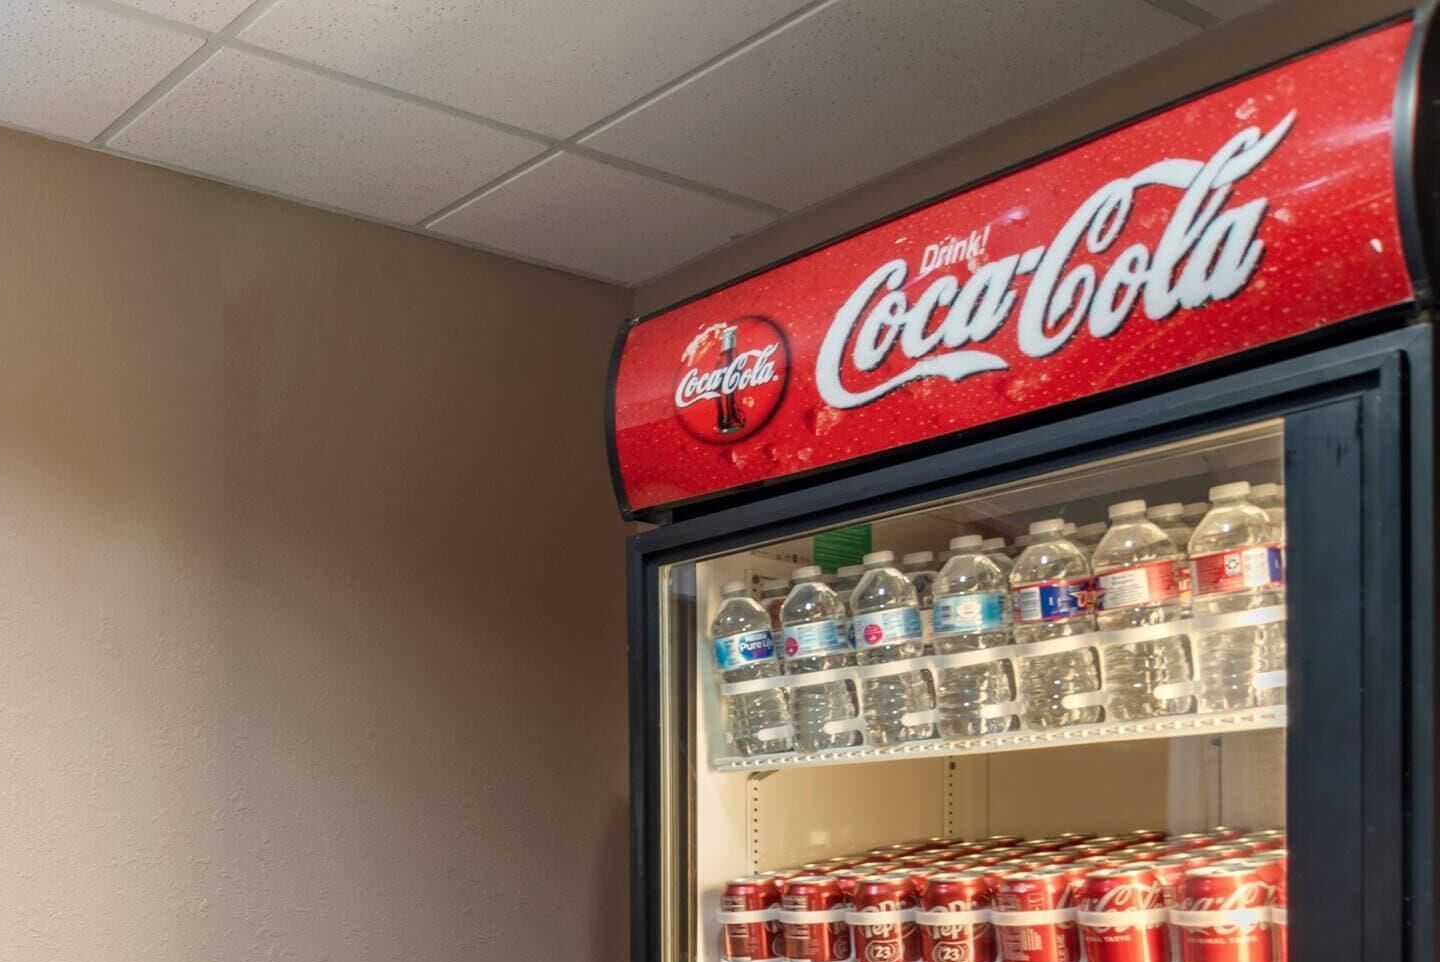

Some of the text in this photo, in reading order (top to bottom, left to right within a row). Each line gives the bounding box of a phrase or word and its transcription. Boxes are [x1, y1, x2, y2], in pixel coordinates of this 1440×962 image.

[815, 108, 1297, 410] Coca-Cola
[920, 226, 991, 273] Drink!
[675, 342, 779, 408] Coca-Cola
[873, 945, 892, 960] 23
[943, 947, 961, 961] 23
